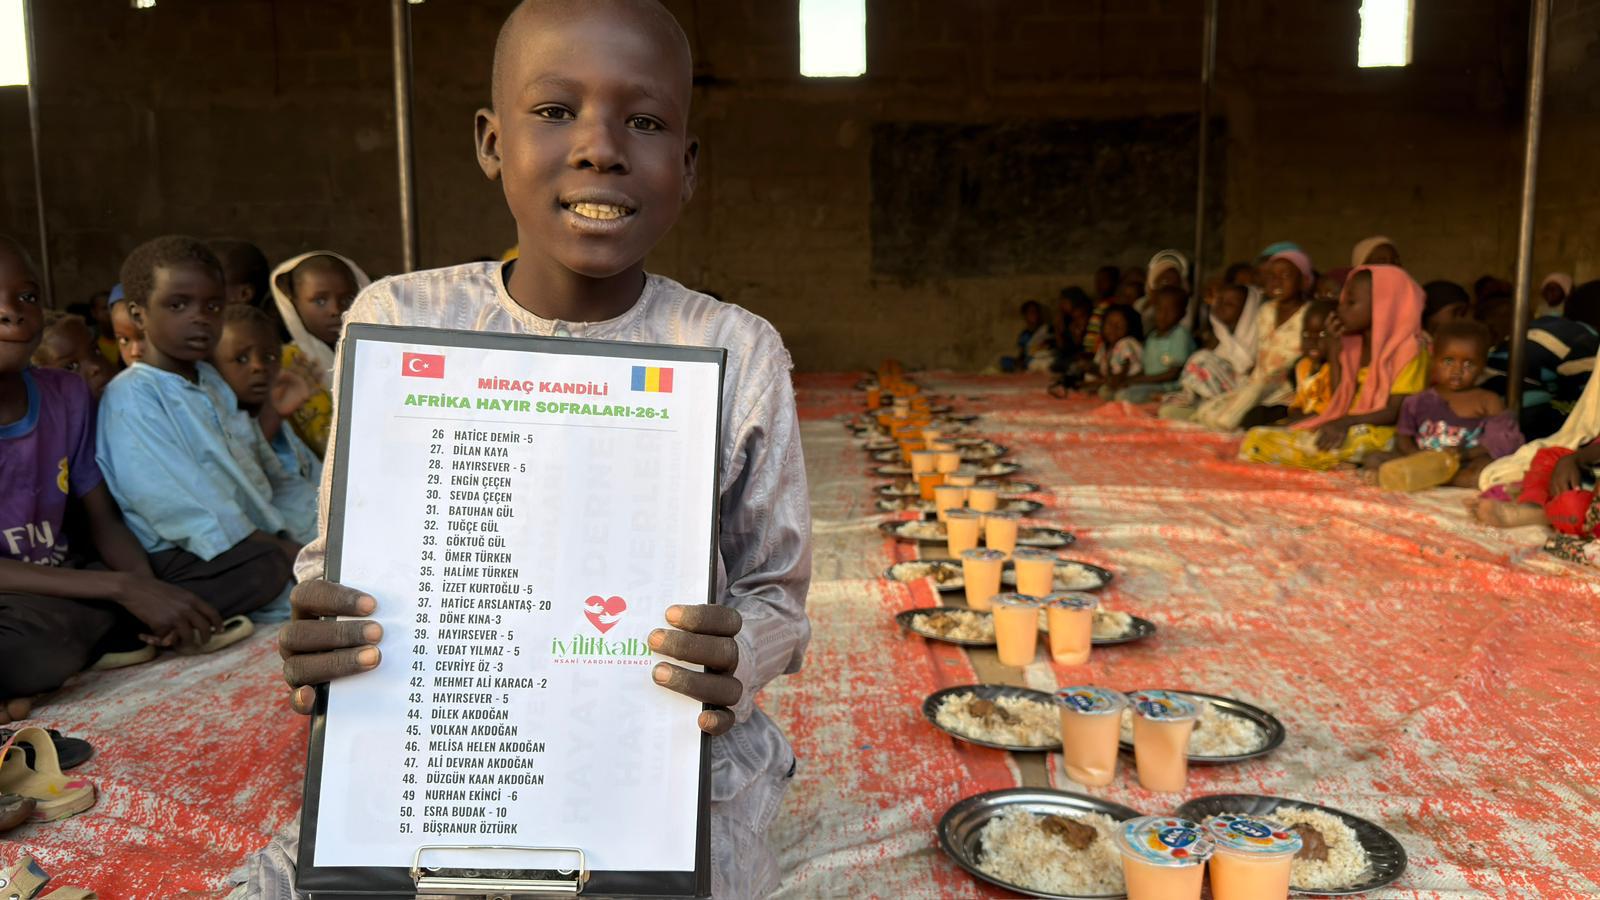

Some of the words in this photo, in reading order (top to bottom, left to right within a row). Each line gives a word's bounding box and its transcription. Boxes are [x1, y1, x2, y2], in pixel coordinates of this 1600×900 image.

[478, 377, 534, 395] MİRAÇ
[539, 381, 608, 396] KANDİLİ
[404, 394, 471, 409] AFRİKA
[476, 398, 531, 413] HAYIR
[536, 402, 670, 419] SOFRALARI-26-1
[432, 429, 444, 439] 26
[454, 429, 487, 442] HATİCE
[490, 431, 520, 443] DEMİR
[523, 434, 533, 443] -5
[430, 444, 443, 454] 27.
[453, 443, 481, 456] DİLAN
[484, 447, 508, 457] KAYA
[429, 459, 443, 469] 28.
[452, 460, 510, 473] HAYIRSEVER
[520, 463, 526, 473] 5
[427, 474, 442, 484] 29.
[451, 473, 479, 486] ENGİN
[482, 476, 511, 489] ÇEÇEN
[426, 489, 441, 499] 30.
[450, 490, 479, 501] SEVDA
[483, 490, 512, 506] ÇEÇEN
[426, 504, 439, 515] 31.
[449, 504, 493, 517] BATUHAN
[496, 503, 514, 517] GÜL
[424, 520, 438, 530] 32.
[448, 519, 478, 534] TUĞÇE
[481, 520, 498, 533] GÜL
[2, 520, 54, 554] Fly
[423, 535, 437, 545] 33.
[446, 533, 485, 548] GÖKTUĞ
[488, 535, 506, 548] GÜL
[421, 550, 436, 561] 34.
[445, 549, 472, 562] ÖMER
[475, 550, 512, 563] TÜRKEN
[420, 566, 435, 576] 35.
[444, 565, 479, 578] HALİME
[482, 565, 519, 578] TÜRKEN
[419, 582, 433, 592] 36.
[442, 579, 466, 594] İZZET
[469, 581, 520, 594] KURTOĞLU
[523, 585, 533, 594] -5
[418, 597, 431, 607] 37.
[441, 596, 475, 609] HATİCE
[478, 599, 536, 613] ARSLANTAŞ-
[539, 600, 551, 610] 20
[416, 613, 431, 623] 38.
[440, 611, 465, 624] DÖNE
[468, 614, 502, 624] KINA-3
[414, 628, 429, 639] 39.
[438, 629, 497, 640] HAYIRSEVER
[507, 630, 513, 641] 5
[412, 645, 428, 655] 40.
[437, 645, 467, 655] VEDAT
[470, 645, 504, 656] YILMAZ
[514, 646, 520, 656] 5
[412, 661, 425, 671] 41.
[435, 659, 475, 672] CEVRİYE
[478, 659, 490, 672] ÖZ
[493, 662, 503, 672] -3
[410, 676, 425, 687] 42.
[434, 676, 474, 687] MEHMET
[476, 675, 491, 688] ALİ
[494, 678, 533, 688] KARACA
[537, 678, 547, 689] -2
[408, 693, 423, 703] 43.
[432, 693, 492, 705] HAYIRSEVER
[503, 694, 509, 704] 5
[407, 709, 422, 719] 44.
[431, 706, 459, 719] DİLEK
[462, 707, 509, 721] AKDOĞAN
[406, 725, 421, 736] 45.
[430, 725, 468, 737] VOLKAN
[471, 723, 518, 736] AKDOĞAN
[405, 741, 420, 752] 46.
[429, 738, 463, 753] MELİSA
[467, 742, 496, 752] HELEN
[499, 740, 545, 754] AKDOĞAN
[404, 757, 418, 768] 47.
[427, 754, 443, 769] ALİ
[446, 757, 484, 769] DEVRAN
[487, 756, 534, 769] AKDOĞAN
[402, 773, 417, 784] 48.
[426, 771, 465, 784] DÜZGÜN
[469, 774, 495, 784] KAAN
[497, 772, 544, 785] AKDOĞAN
[402, 790, 415, 800] 49
[425, 790, 466, 800] NURHAN
[469, 788, 501, 801] EKİNCİ
[507, 791, 518, 801] -6
[400, 806, 415, 817] 50.
[424, 806, 448, 818] ESRA
[452, 807, 486, 819] BUDAK
[496, 807, 507, 819] 10
[400, 823, 413, 833] 51.
[423, 820, 477, 836] BÜŞRANUR
[480, 821, 518, 834] ÖZTÜRK
